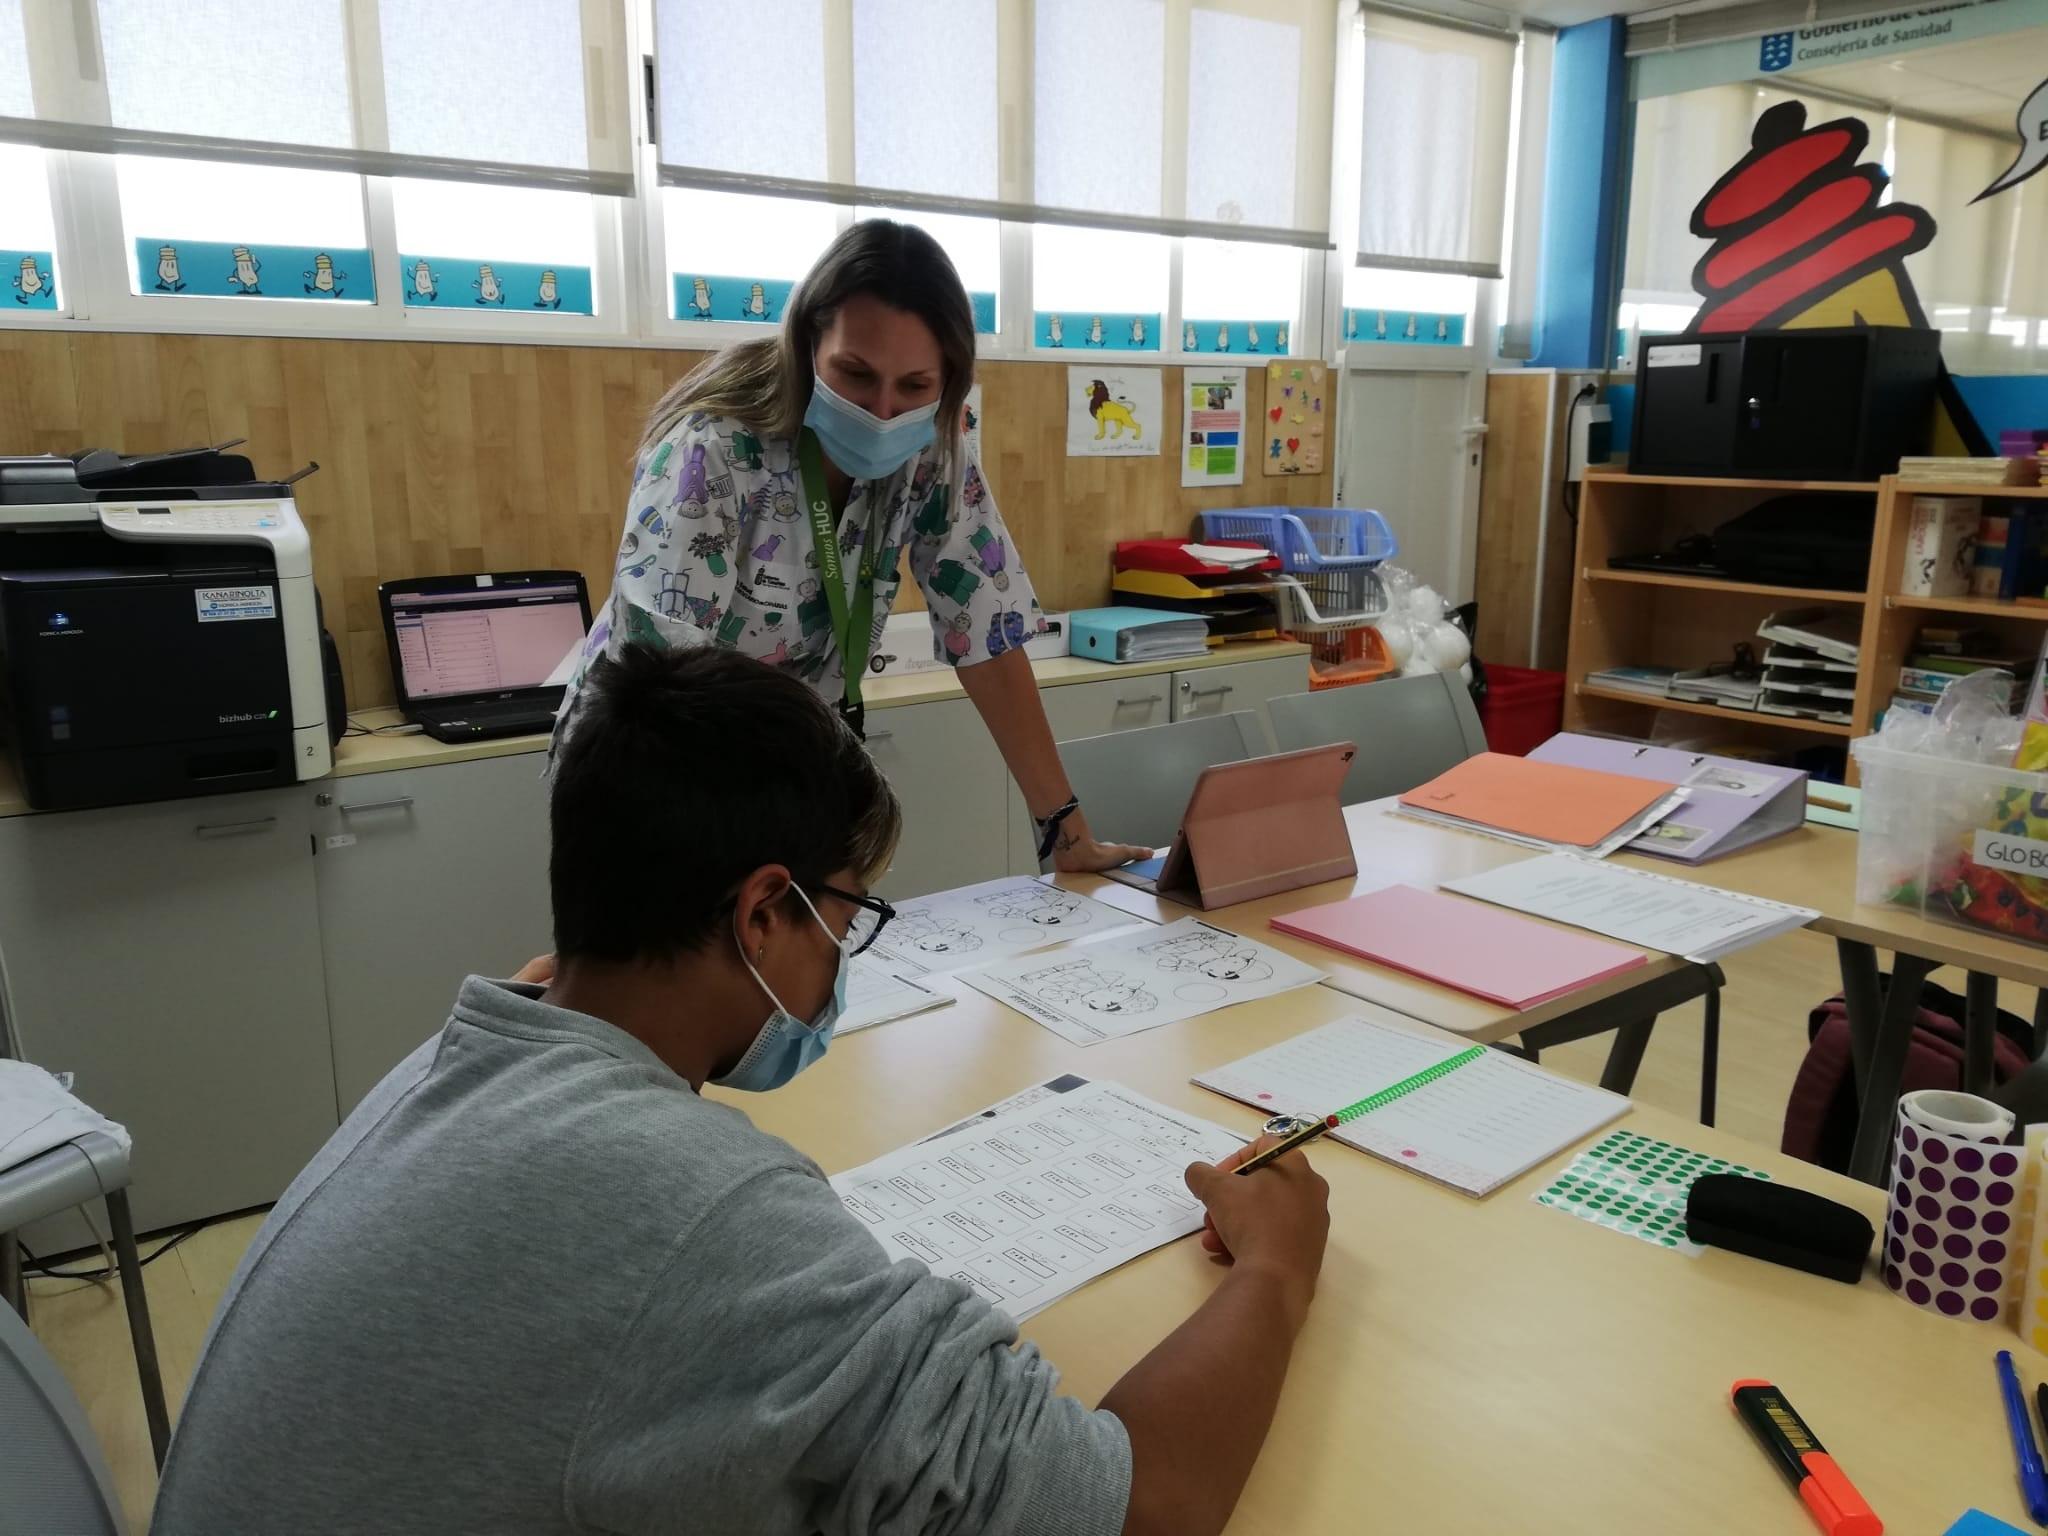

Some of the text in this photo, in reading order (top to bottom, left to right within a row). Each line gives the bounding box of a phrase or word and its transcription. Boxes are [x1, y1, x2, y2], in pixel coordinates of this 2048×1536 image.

[1872, 33, 1889, 48] de
[1893, 19, 1952, 43] Sanidad
[813, 500, 838, 579] Somos HUC
[219, 713, 252, 723] bizhub
[306, 746, 314, 757] 2
